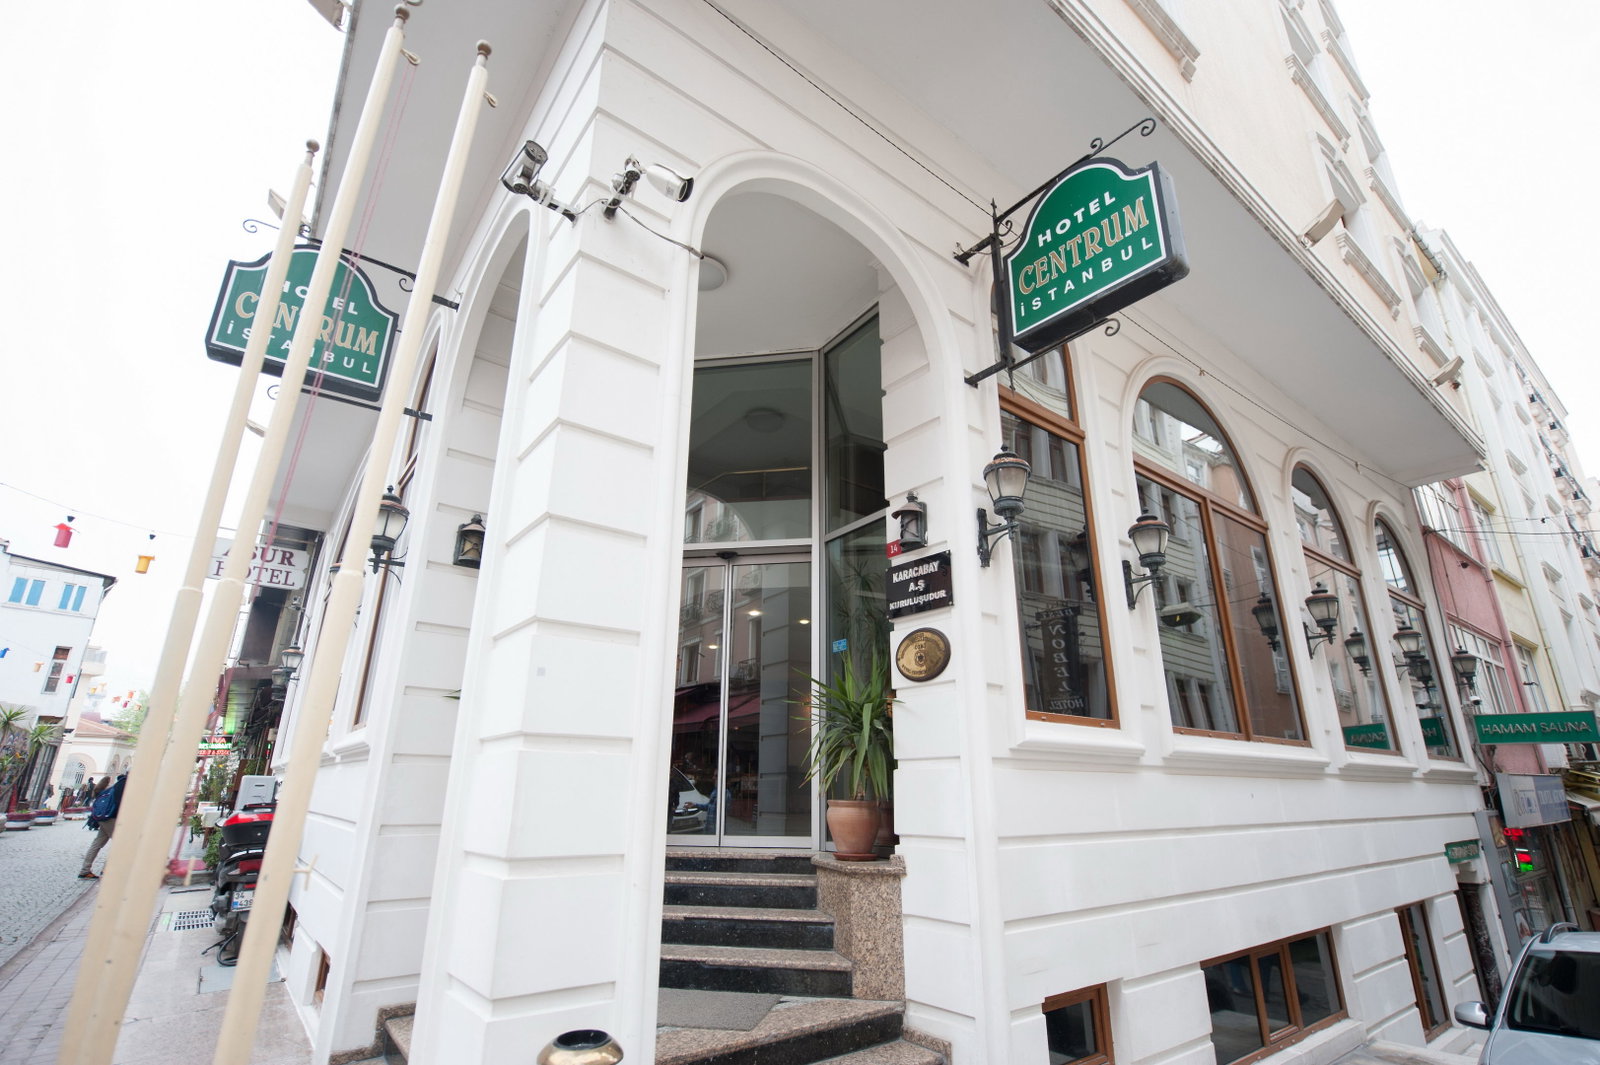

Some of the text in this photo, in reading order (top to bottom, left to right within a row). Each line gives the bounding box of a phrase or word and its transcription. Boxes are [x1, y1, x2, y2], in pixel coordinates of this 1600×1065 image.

[1037, 191, 1115, 247] HOTEL
[1018, 196, 1149, 295] CENTRUM
[235, 291, 379, 356] CNRUM
[890, 544, 898, 554] 14
[213, 560, 295, 587] HTEL
[892, 560, 940, 583] KARACABAY
[908, 579, 926, 592] A.Ş
[889, 589, 947, 611] KURULUŞUDUR
[1481, 721, 1592, 735] HAMAM SAUNA
